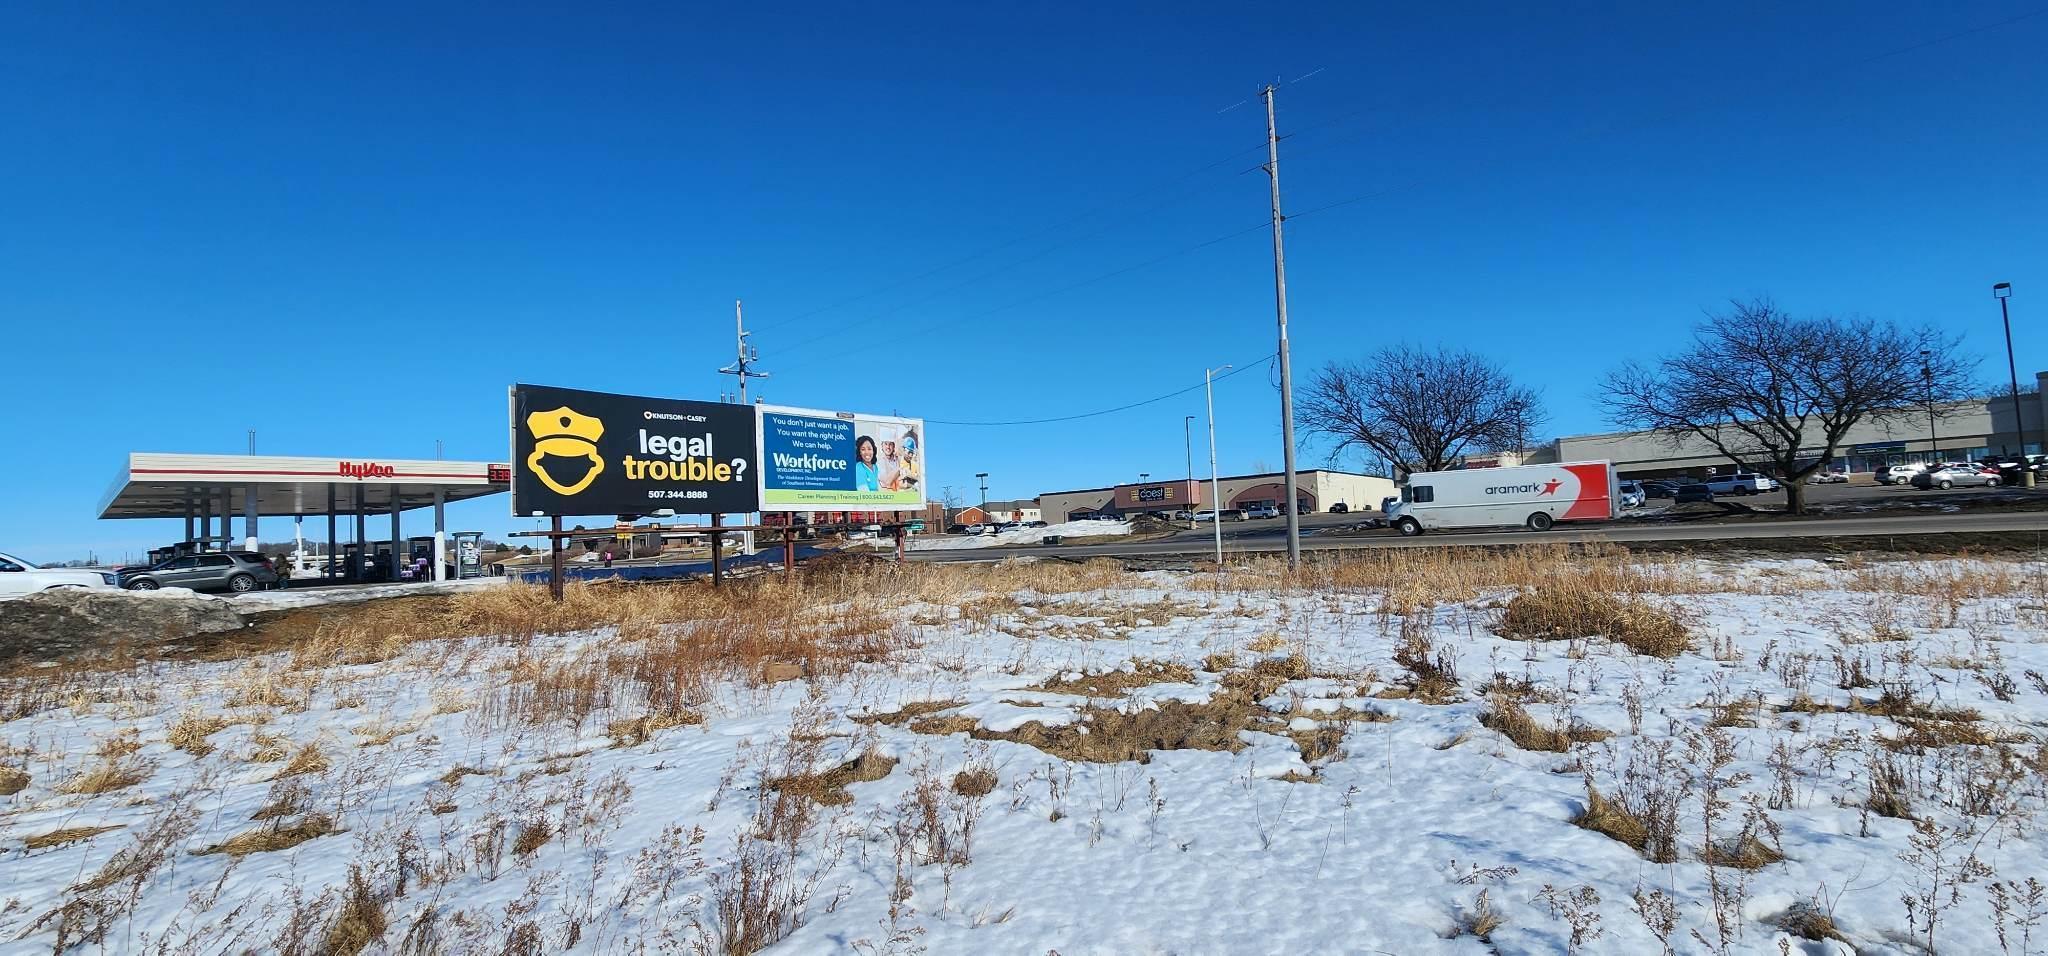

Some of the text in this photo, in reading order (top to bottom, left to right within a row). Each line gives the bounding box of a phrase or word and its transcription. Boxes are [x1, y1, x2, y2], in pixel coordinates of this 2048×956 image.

[773, 417, 786, 425] You
[787, 418, 803, 427] don't
[805, 420, 816, 428] just
[838, 423, 849, 431] job.
[777, 428, 790, 436] You
[791, 430, 806, 438] want
[820, 432, 835, 440] right
[834, 433, 846, 441] job.
[639, 429, 712, 461] legal
[792, 440, 804, 448] We
[817, 441, 832, 451] help.
[773, 452, 847, 471] Workforce
[623, 455, 747, 482] trouble?
[648, 490, 708, 499] 507.344.8888
[1485, 482, 1540, 495] aramark
